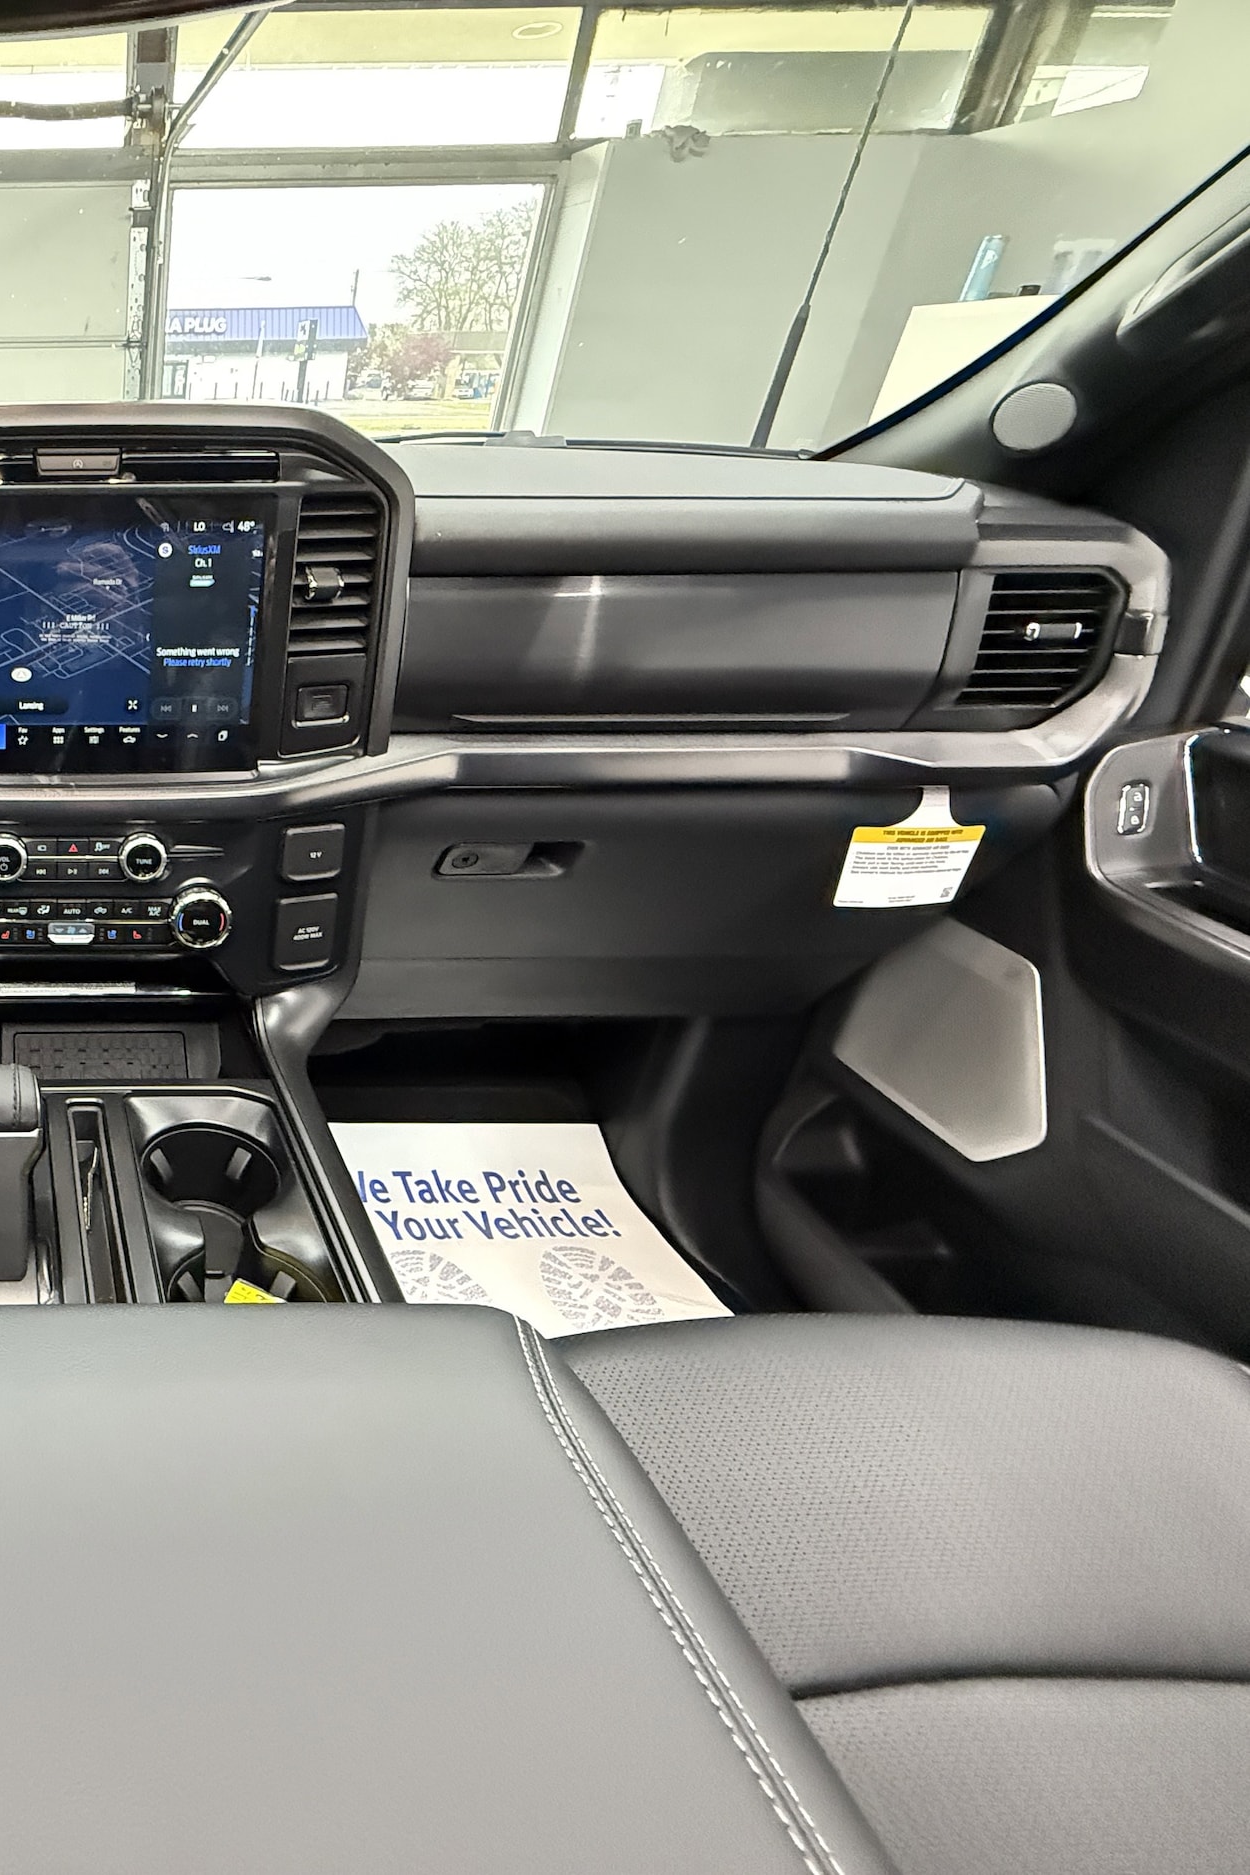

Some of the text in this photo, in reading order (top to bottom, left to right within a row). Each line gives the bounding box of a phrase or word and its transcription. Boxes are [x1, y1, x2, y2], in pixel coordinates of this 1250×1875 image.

[184, 316, 227, 333] PLUG
[194, 521, 206, 532] LO
[156, 647, 240, 658] Something went wrong
[163, 658, 232, 668] Please retry shortly
[392, 1169, 479, 1204] Take
[483, 1169, 583, 1204] Pride
[375, 1207, 622, 1241] Your Vehicle!
